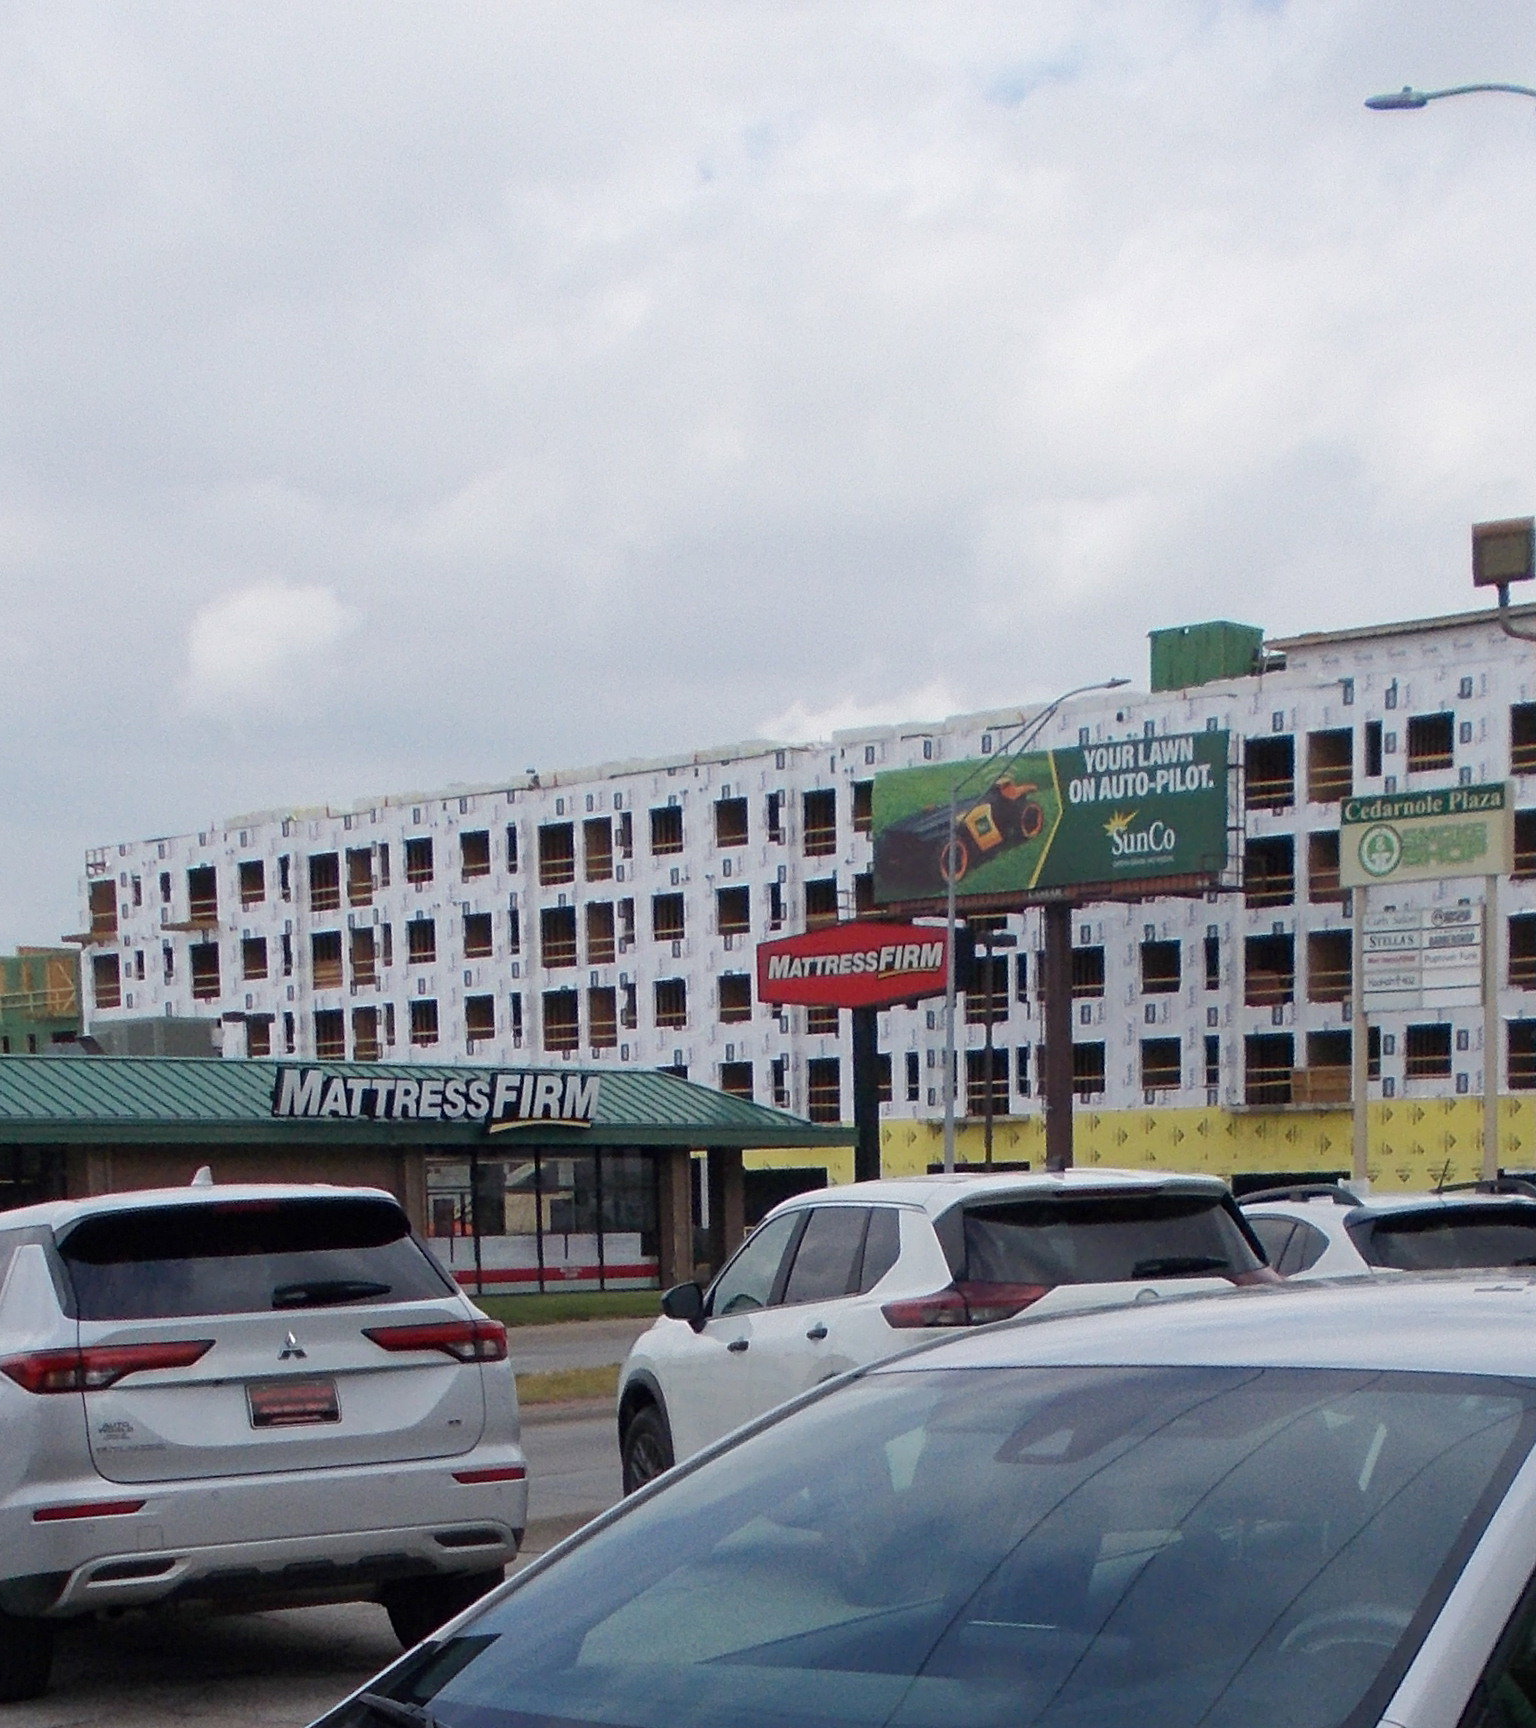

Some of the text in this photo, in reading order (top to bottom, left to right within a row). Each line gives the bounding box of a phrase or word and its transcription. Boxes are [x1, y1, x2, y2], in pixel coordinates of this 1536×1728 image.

[1084, 736, 1193, 773] YOUR LAWN
[1069, 763, 1214, 803] ON AUTO-PILOT.
[1345, 790, 1502, 821] Cedarnole Plaza
[1112, 820, 1175, 855] SunCo
[1369, 934, 1414, 948] STELLA'S
